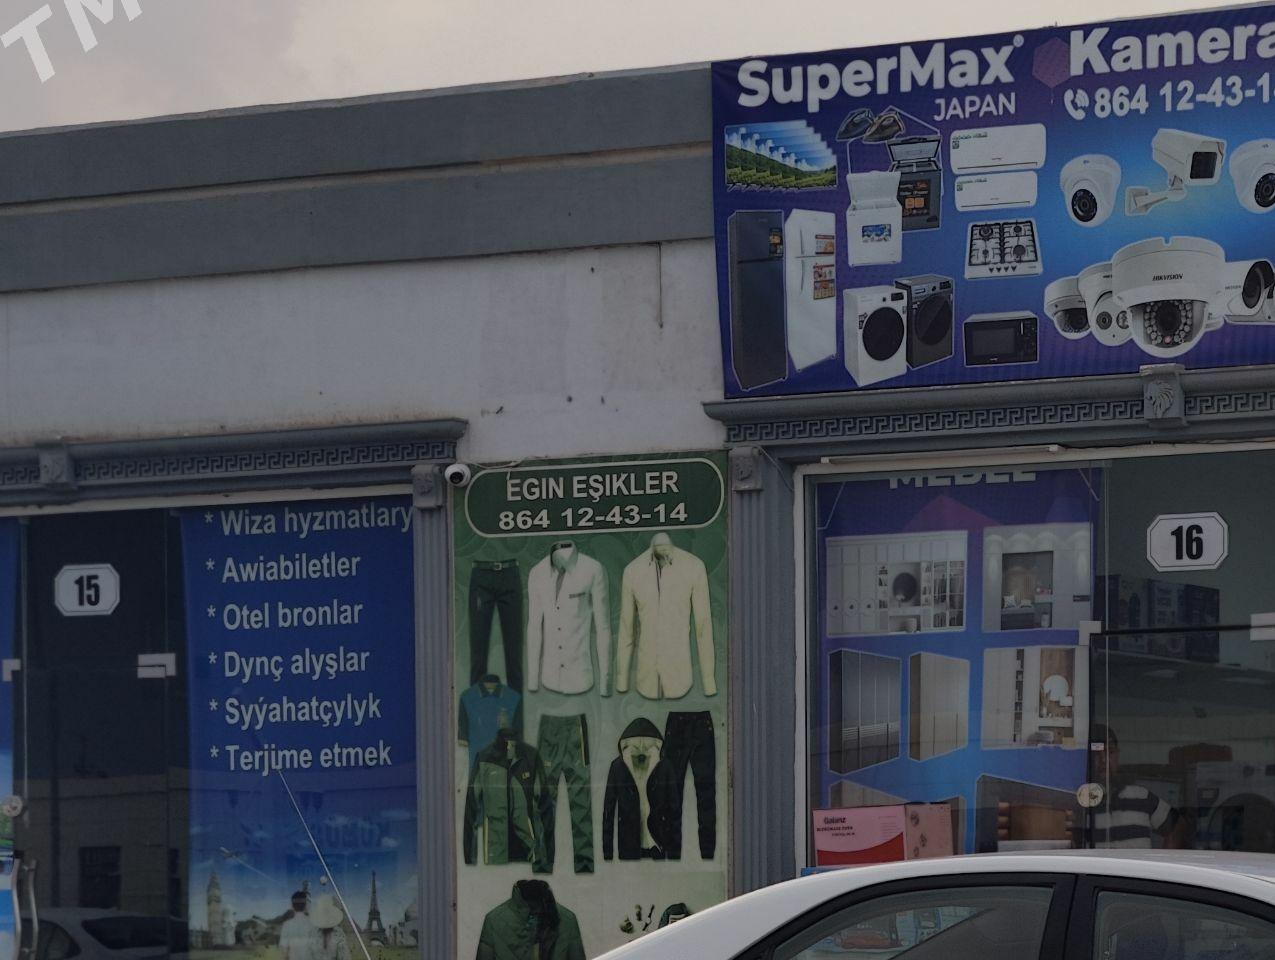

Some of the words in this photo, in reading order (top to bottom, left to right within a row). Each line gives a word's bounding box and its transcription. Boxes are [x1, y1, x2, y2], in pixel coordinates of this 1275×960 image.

[737, 42, 1016, 113] SuperMax
[933, 92, 1016, 121] JAPAN
[1094, 84, 1149, 118] 864
[506, 477, 564, 501] EGIN
[572, 471, 680, 502] EŞIKLER
[220, 509, 276, 536] Wiza
[284, 502, 414, 539] hyzmatlary
[499, 509, 551, 531] 864
[560, 503, 688, 528] 12-43-14
[1170, 524, 1204, 560] 16
[221, 551, 361, 583] Awiabiletler
[74, 575, 100, 606] 15
[223, 602, 270, 630] Otel
[278, 599, 363, 628] bronlar
[224, 651, 284, 683] Dynç
[290, 646, 370, 680] alyşlar
[225, 692, 382, 731] Syýahatçylyk
[225, 744, 312, 777] Terjime
[319, 740, 392, 767] etmek
